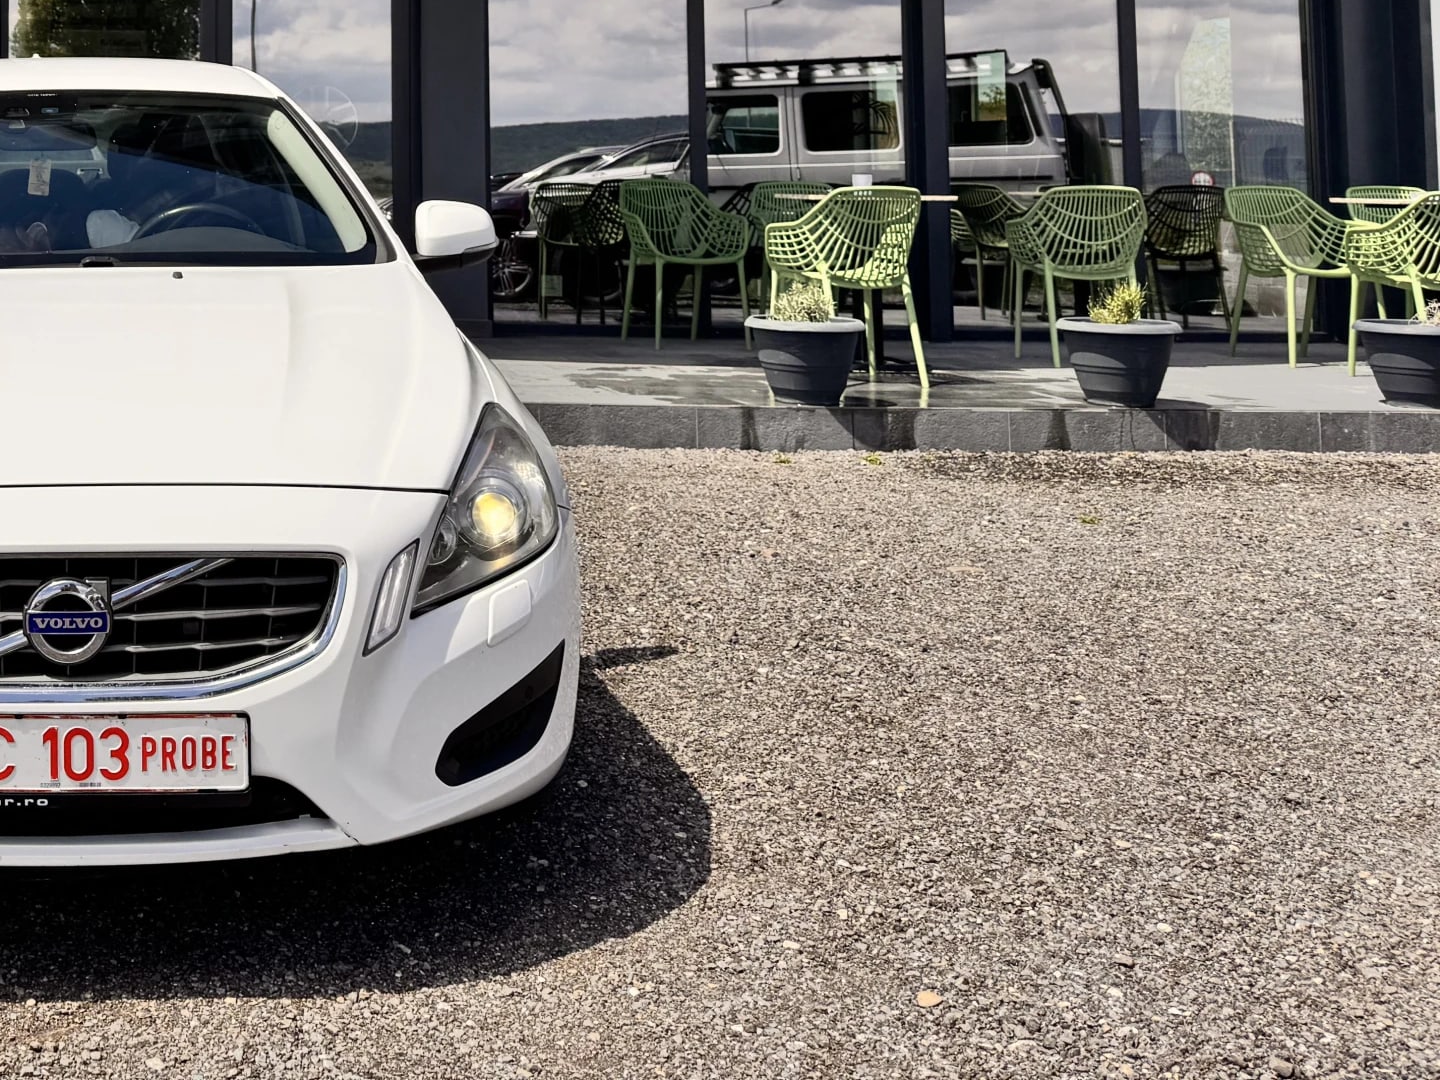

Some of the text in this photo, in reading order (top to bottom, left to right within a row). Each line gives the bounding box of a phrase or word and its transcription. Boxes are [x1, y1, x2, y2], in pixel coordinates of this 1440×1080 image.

[32, 617, 103, 629] VOLVO
[41, 725, 130, 782] 103
[140, 735, 238, 773] PROBE
